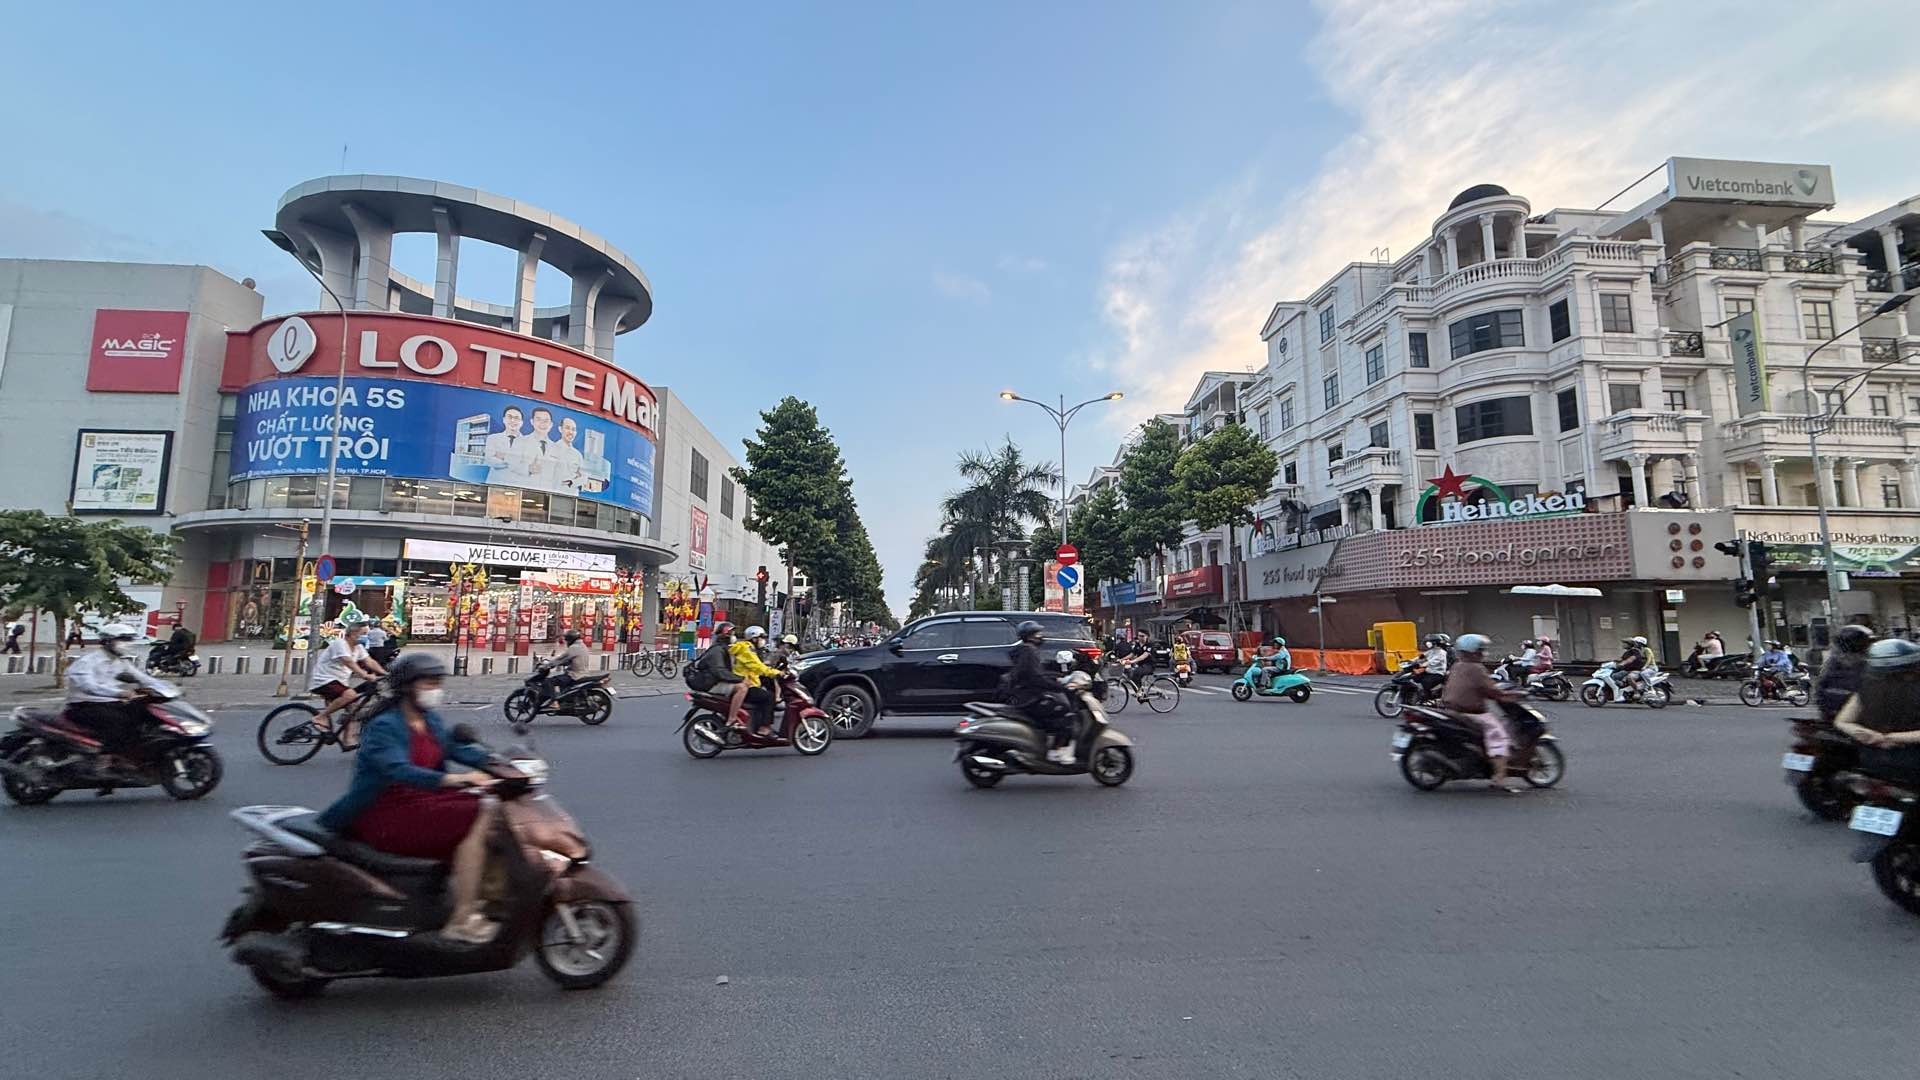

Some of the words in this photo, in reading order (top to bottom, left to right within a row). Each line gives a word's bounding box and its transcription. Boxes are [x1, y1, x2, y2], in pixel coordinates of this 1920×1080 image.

[1687, 175, 1794, 196] Vietcombank
[101, 338, 172, 350] MAGIC
[359, 330, 596, 405] LOTTE
[1744, 341, 1760, 401] Vietcombank
[248, 390, 281, 414] NHA
[286, 386, 358, 408] KHOA
[366, 387, 406, 409] 5S
[257, 411, 298, 435] CHẤT
[248, 434, 308, 466] VƯỢT
[314, 432, 389, 466] TRỘI
[1442, 491, 1586, 522] Heineken
[469, 547, 547, 564] WELCOME!
[1400, 547, 1445, 567] 255
[1454, 543, 1514, 565] food
[1520, 542, 1615, 567] garden
[1263, 569, 1281, 585] 255
[1282, 564, 1305, 582] food
[1307, 562, 1343, 582] garden
